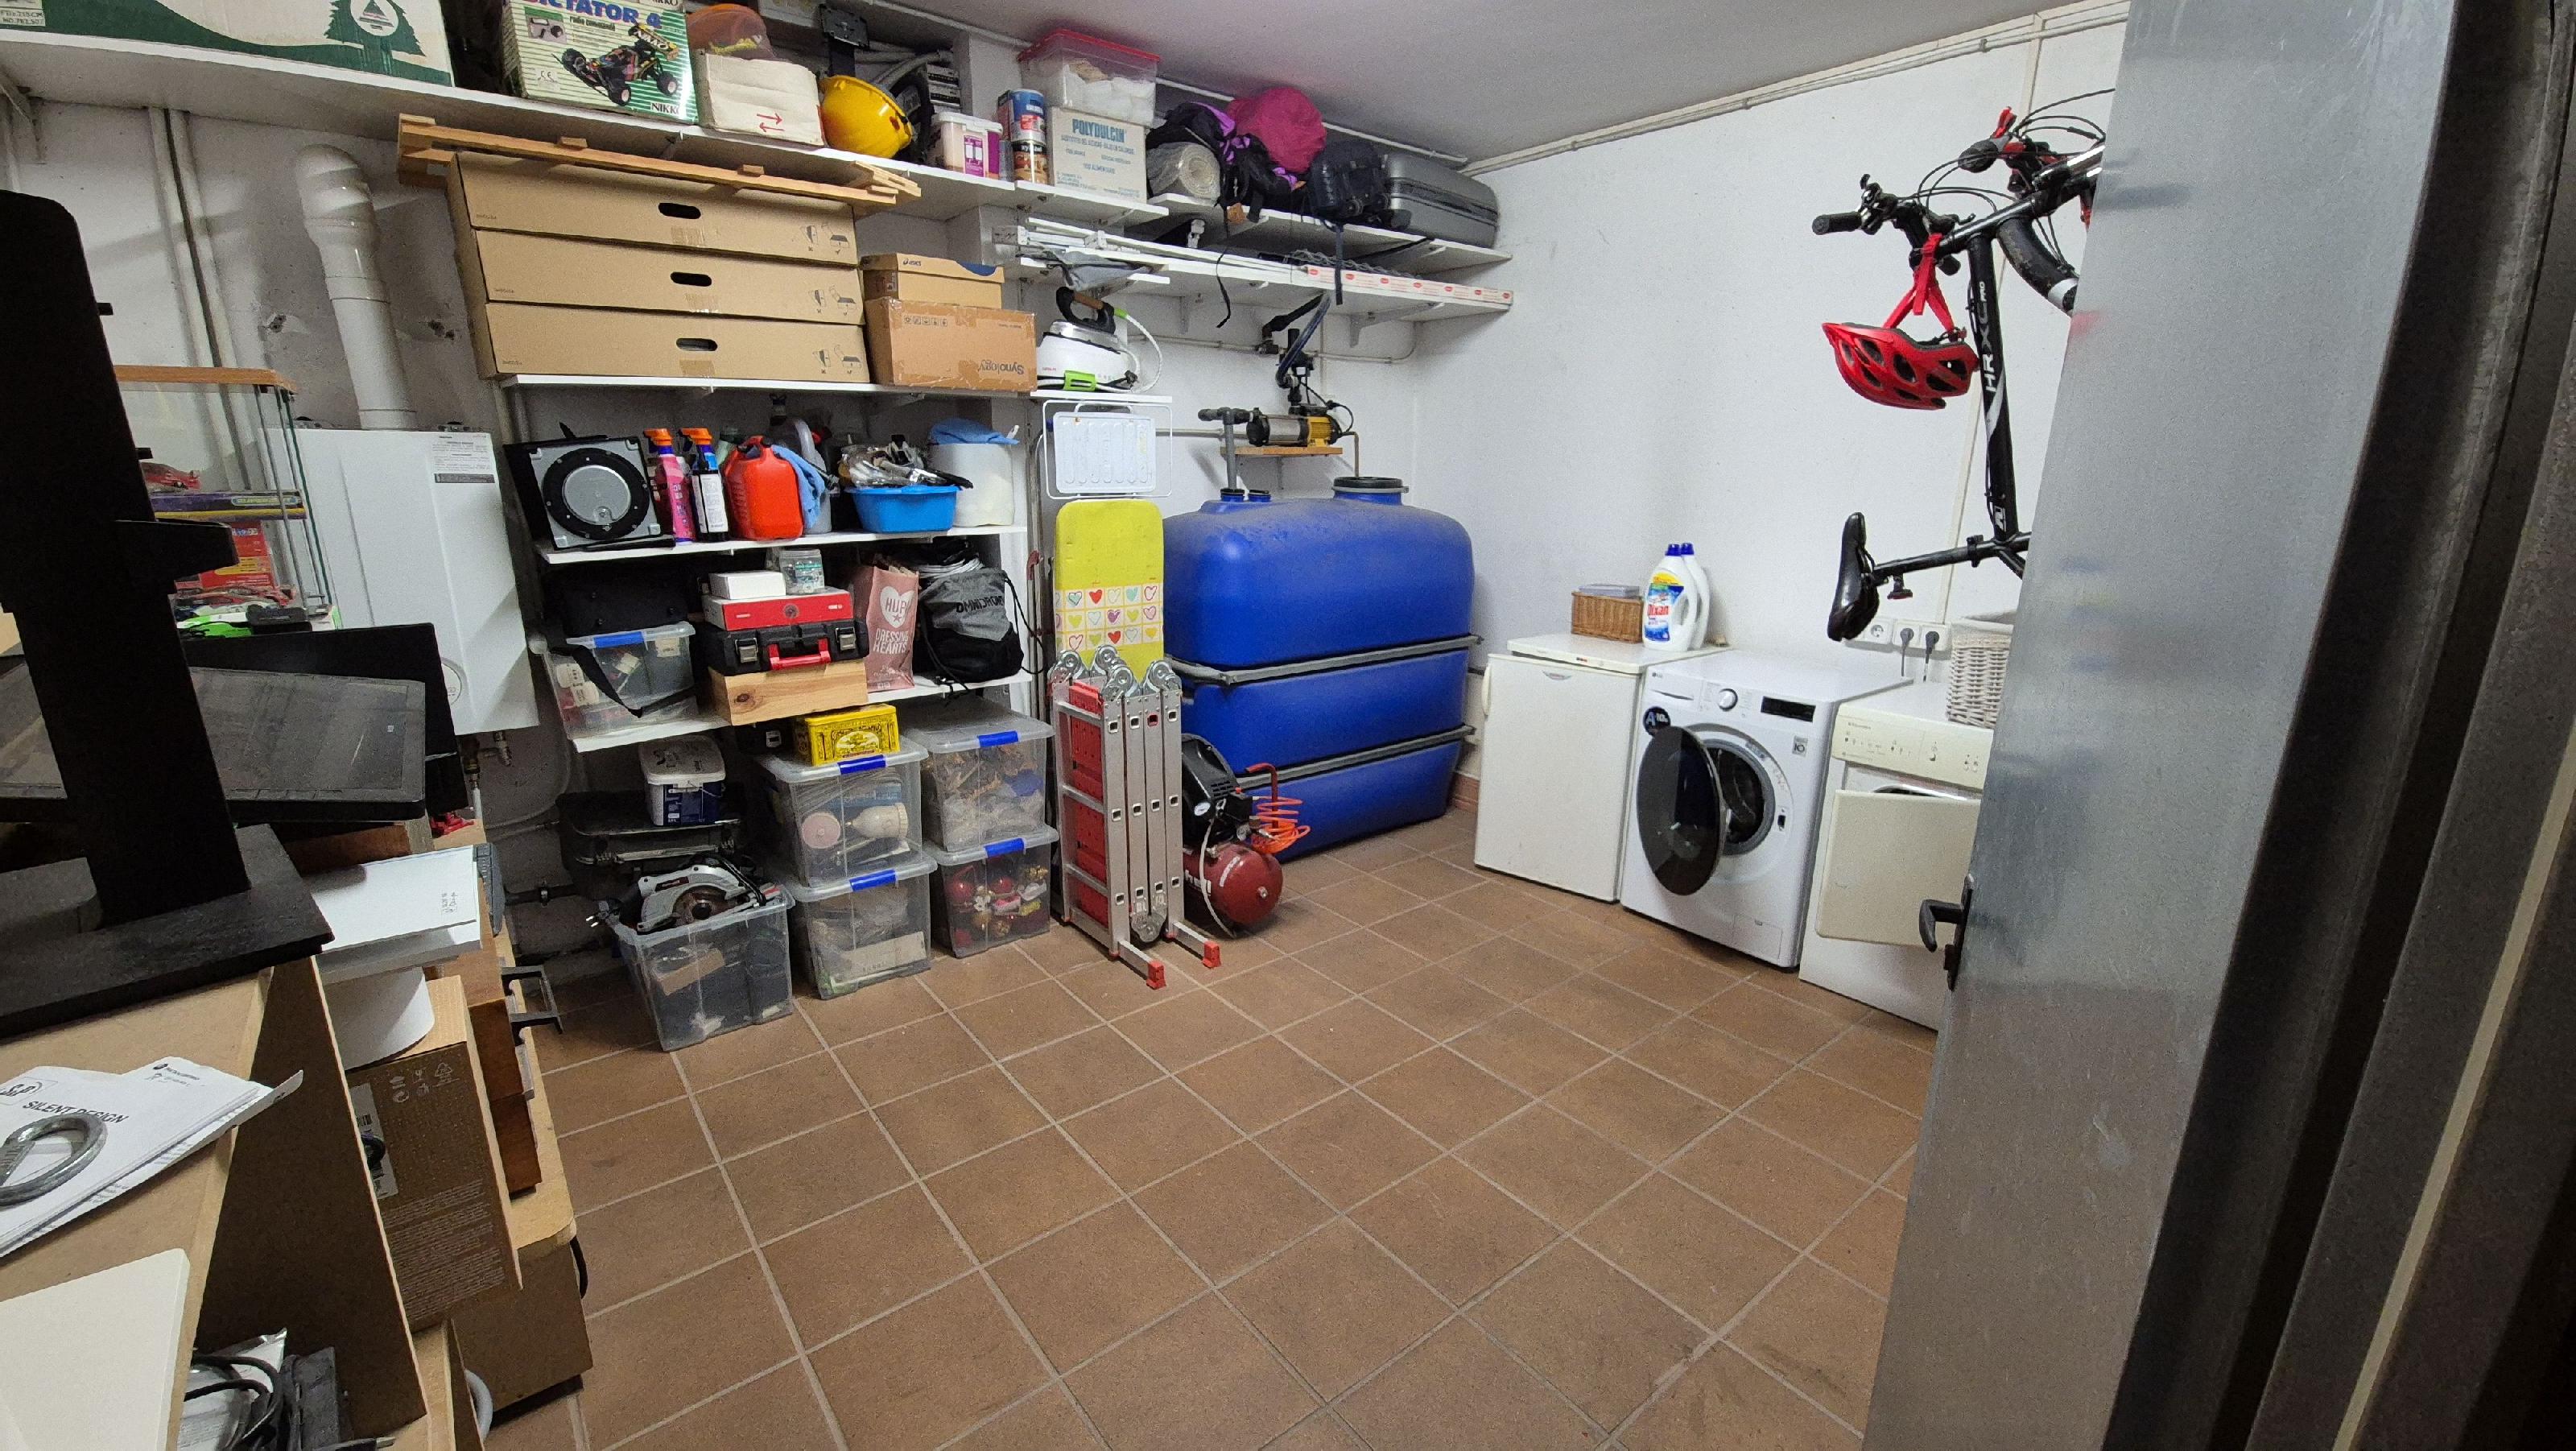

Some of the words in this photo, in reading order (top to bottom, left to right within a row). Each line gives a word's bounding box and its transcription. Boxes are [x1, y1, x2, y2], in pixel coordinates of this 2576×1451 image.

[1072, 118, 1125, 143] POLYDULCIN
[979, 359, 1025, 375] Synology
[1648, 604, 1670, 616] Dixan
[875, 628, 909, 643] DRESSING
[873, 640, 907, 655] HEARTS
[23, 1101, 76, 1114] SILENT
